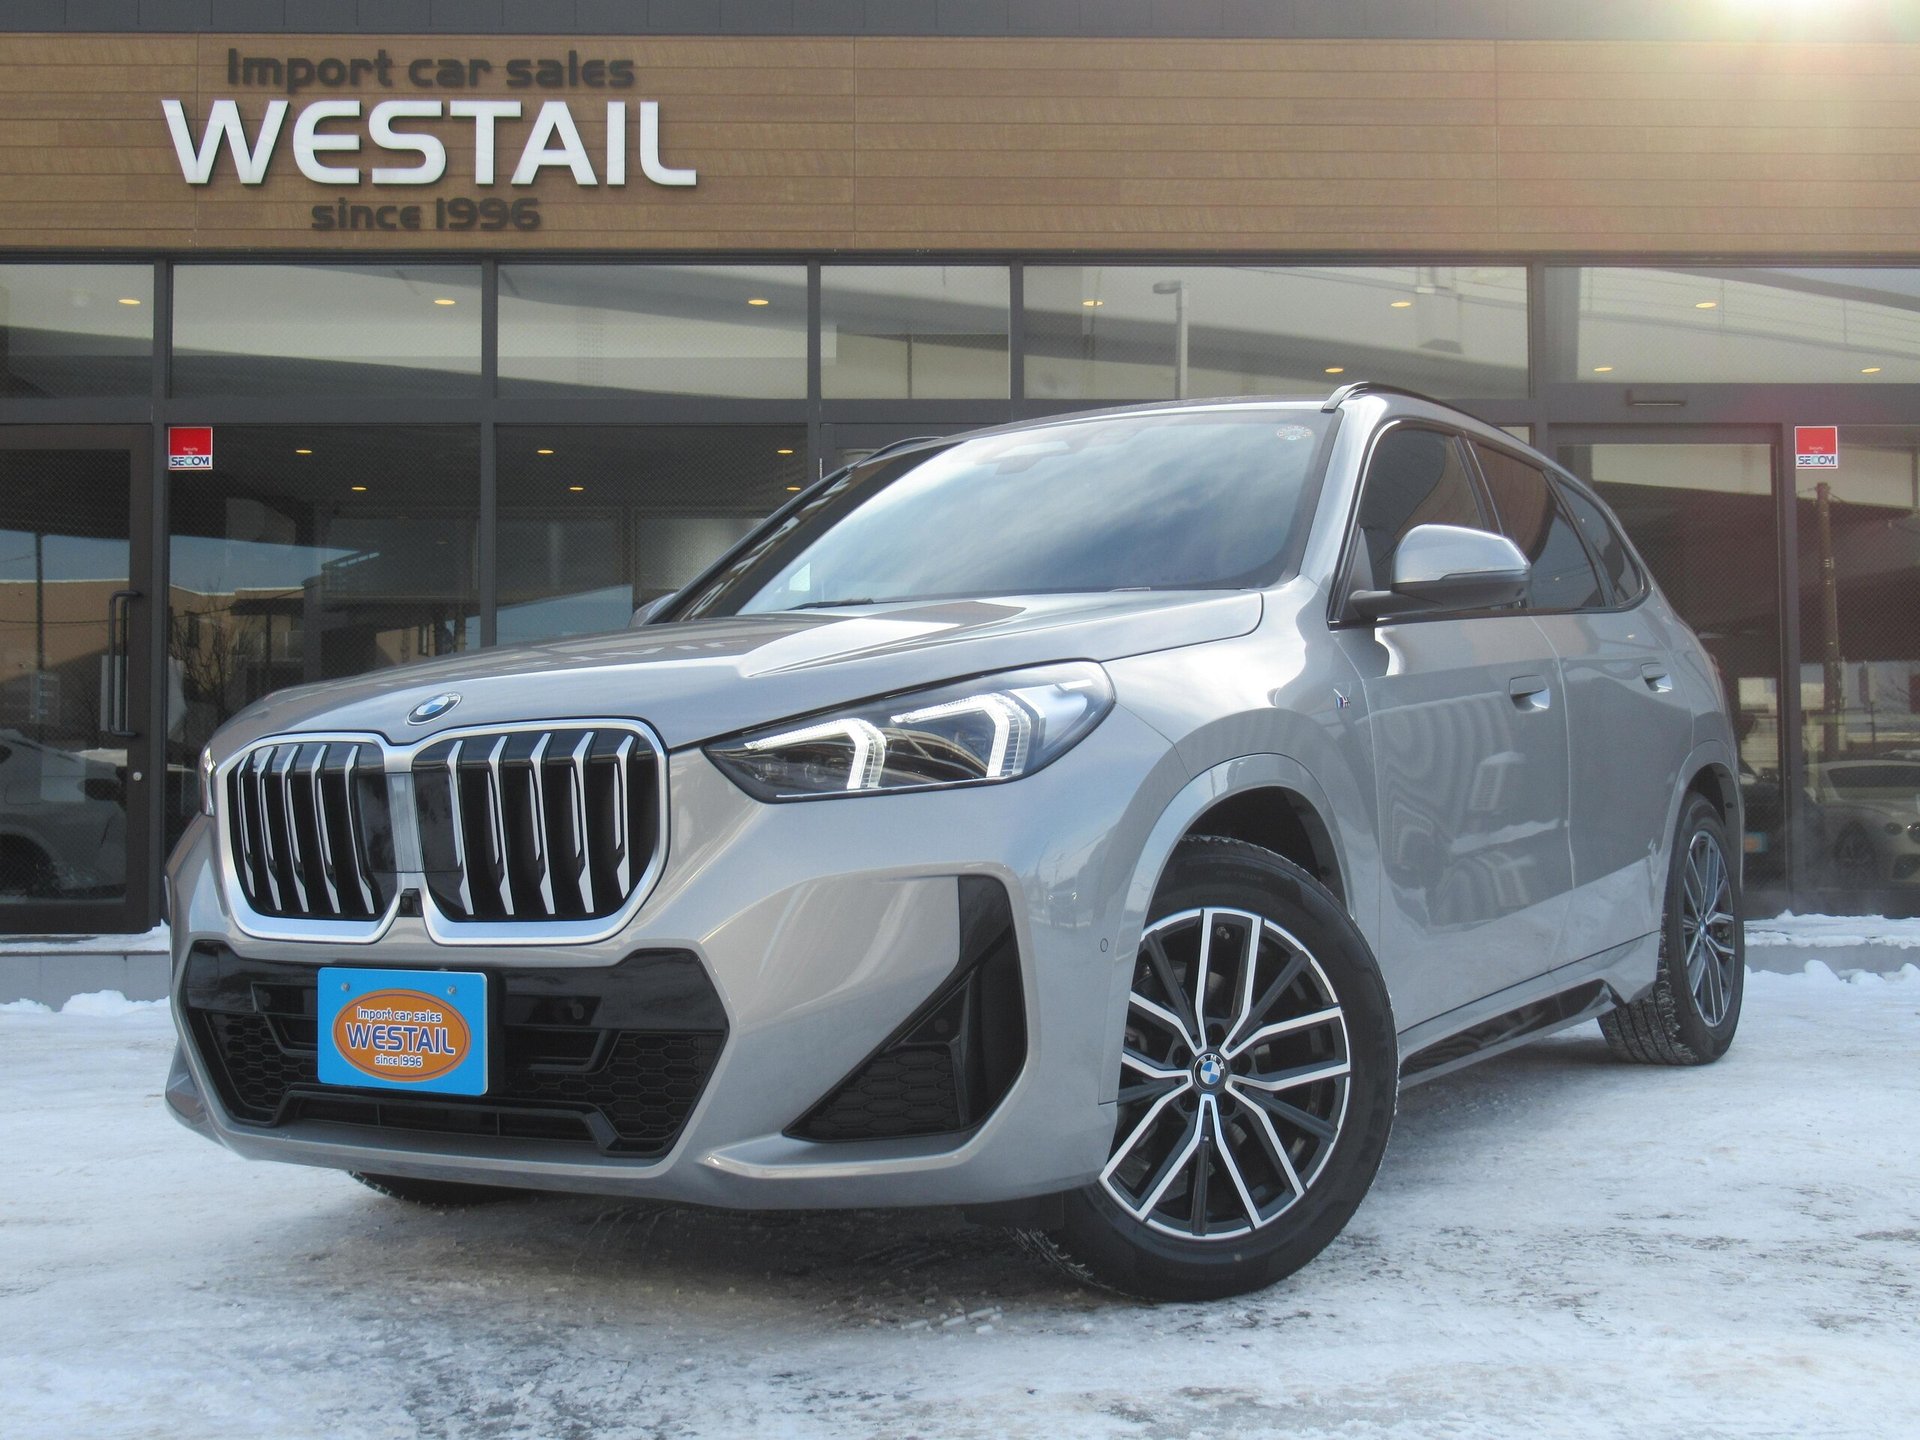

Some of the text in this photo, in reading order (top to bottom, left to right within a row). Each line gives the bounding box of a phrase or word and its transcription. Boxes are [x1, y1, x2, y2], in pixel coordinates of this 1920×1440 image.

[228, 48, 635, 93] Import car sales
[161, 99, 697, 186] WESTAIL
[311, 197, 541, 230] since 1996
[171, 456, 209, 466] SECOM
[1798, 455, 1835, 465] SECOM
[357, 1007, 442, 1022] Import car sales
[346, 1022, 455, 1054] WESTAIL
[375, 1053, 422, 1067] since 1996
